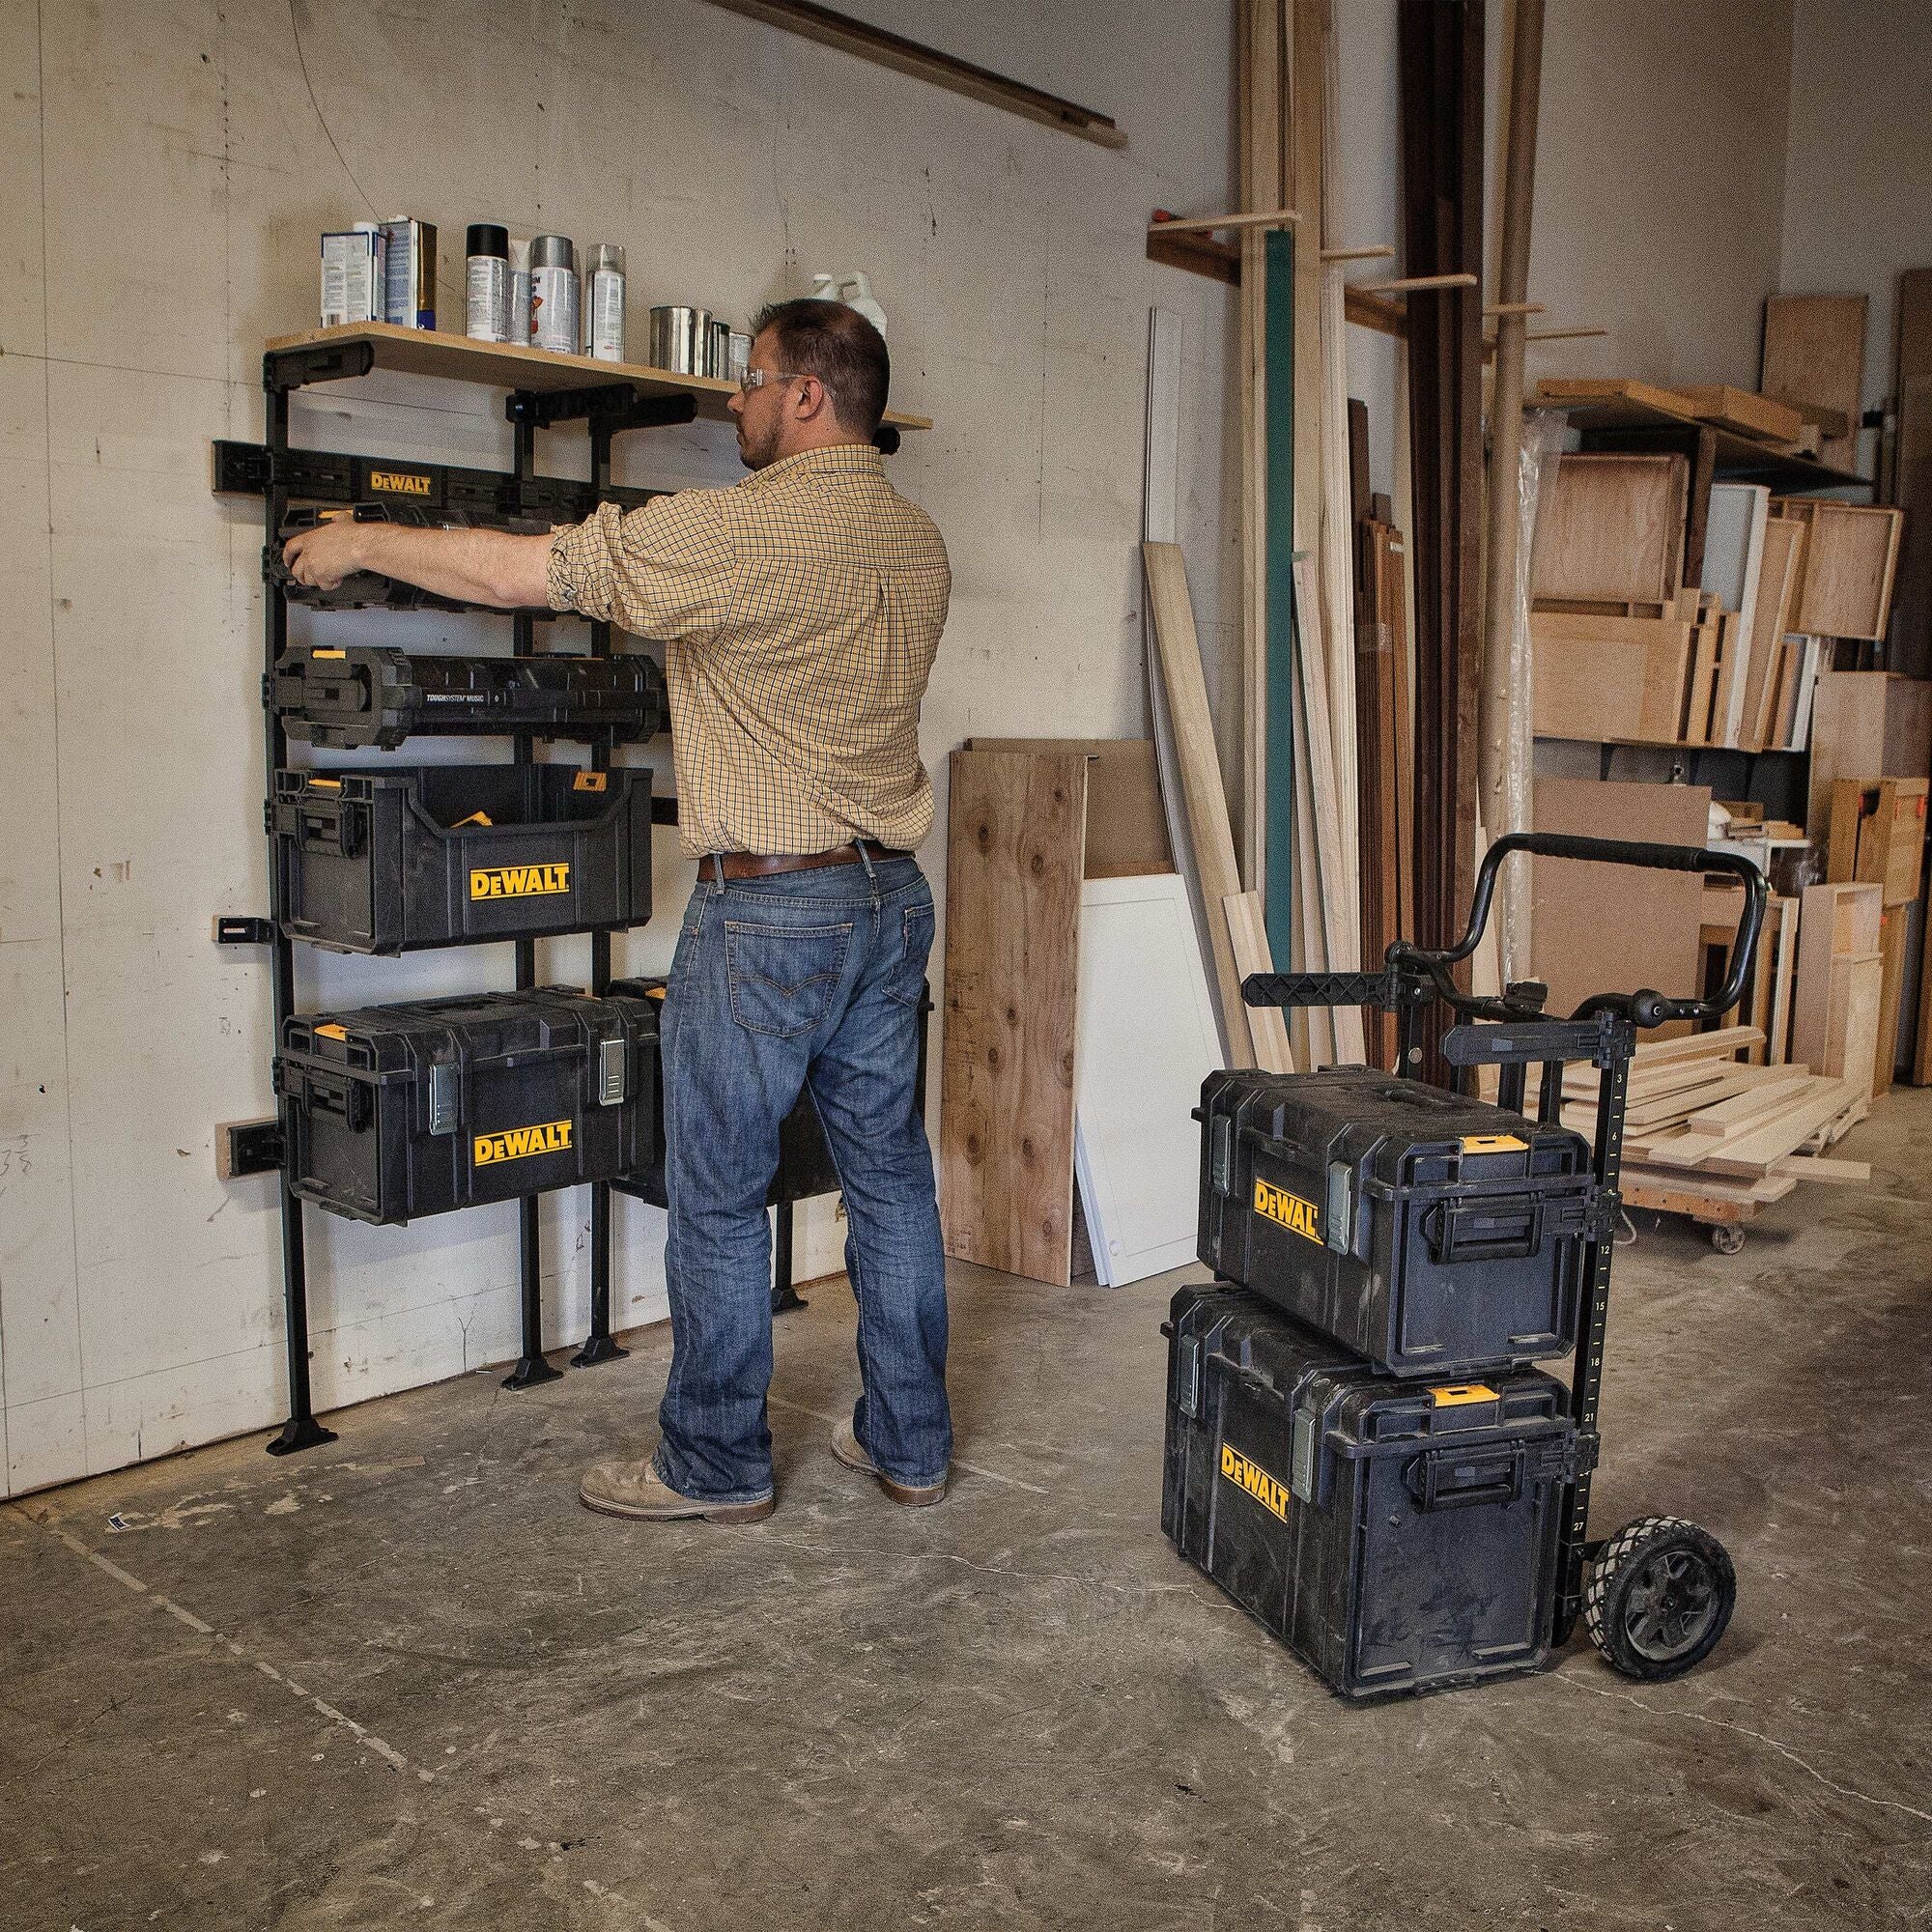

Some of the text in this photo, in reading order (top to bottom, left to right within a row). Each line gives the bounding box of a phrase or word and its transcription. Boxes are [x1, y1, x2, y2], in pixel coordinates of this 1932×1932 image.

[470, 864, 570, 900] DEWALT
[1617, 1074, 1622, 1083] 3
[1611, 1131, 1617, 1140] 6
[474, 1120, 572, 1167] DEWALT
[1601, 1245, 1610, 1255] 12
[1596, 1302, 1605, 1311] 15
[1591, 1357, 1600, 1366] 18
[1584, 1413, 1594, 1422] 21
[1221, 1440, 1290, 1524] DEWALT
[1573, 1521, 1583, 1531] 27
